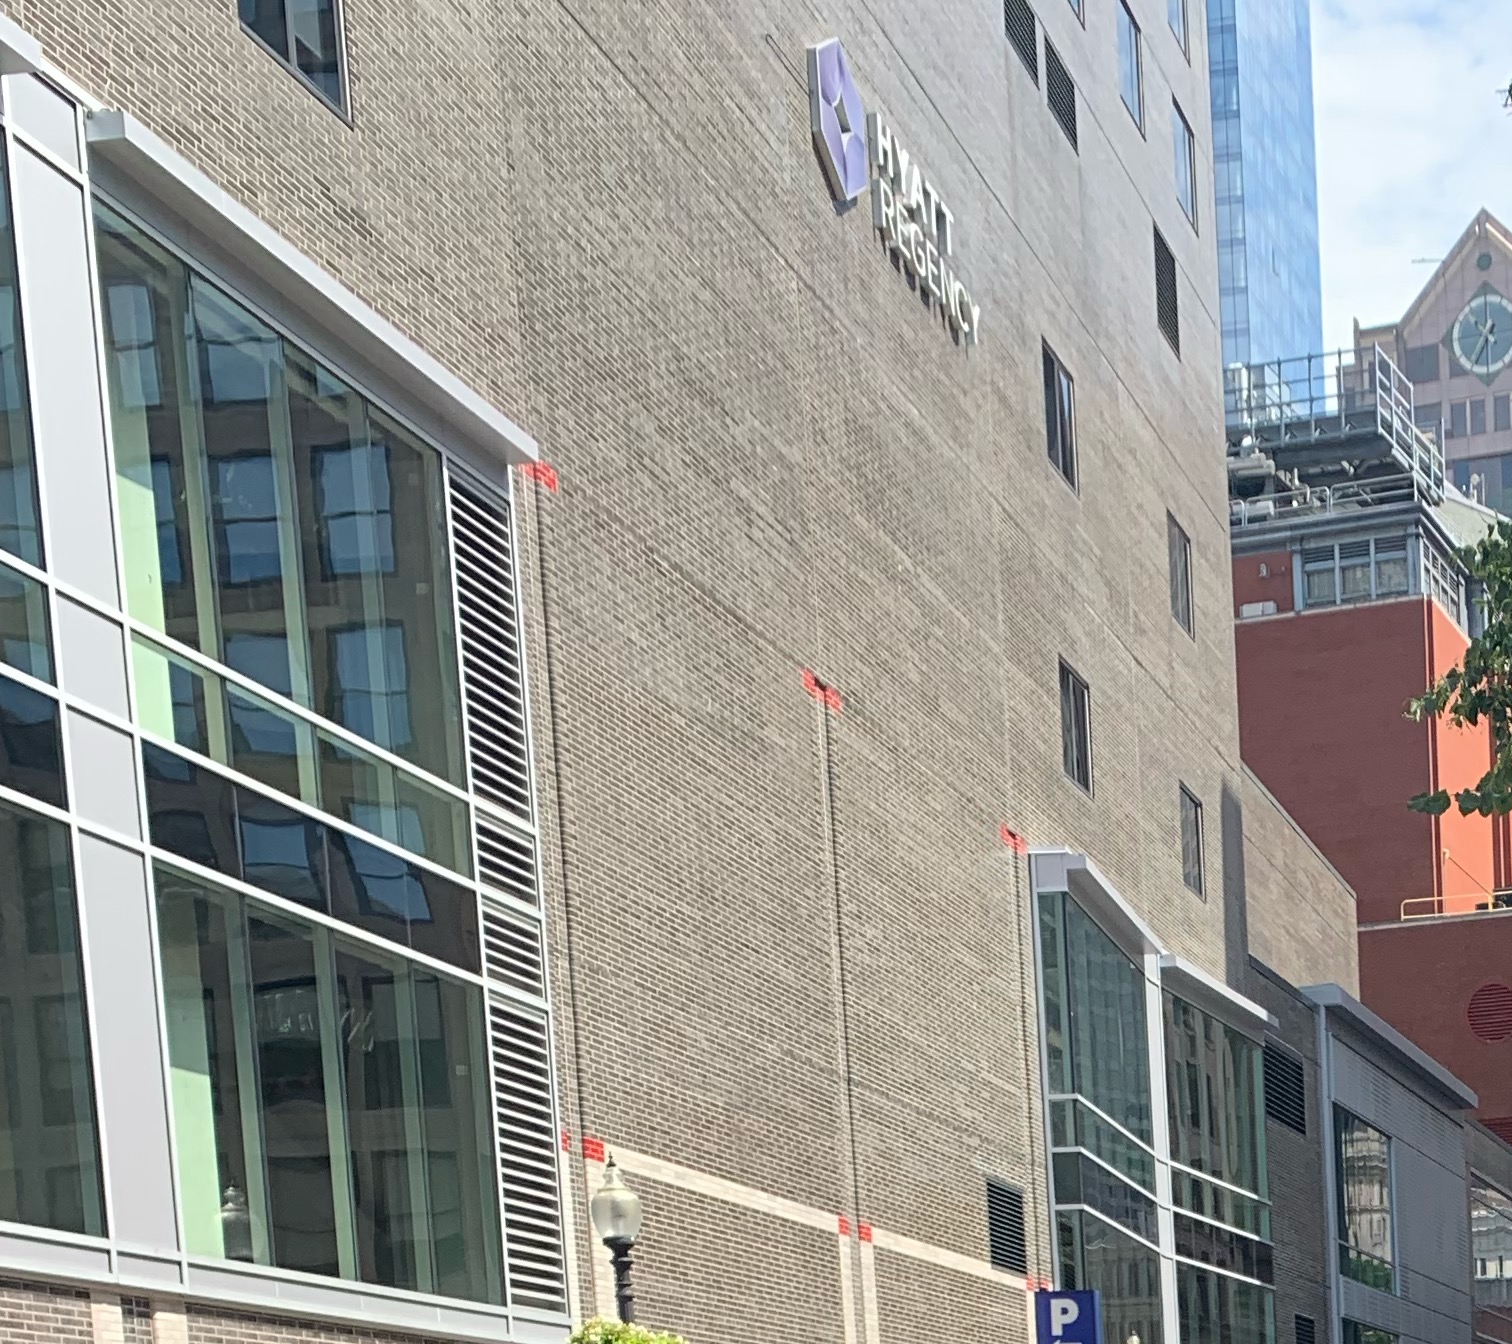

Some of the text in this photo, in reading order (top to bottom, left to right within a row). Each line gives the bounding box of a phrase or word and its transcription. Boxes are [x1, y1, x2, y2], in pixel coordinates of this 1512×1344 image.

[874, 112, 954, 256] HYATT
[879, 178, 980, 344] REGENCY
[1050, 1299, 1079, 1336] P
